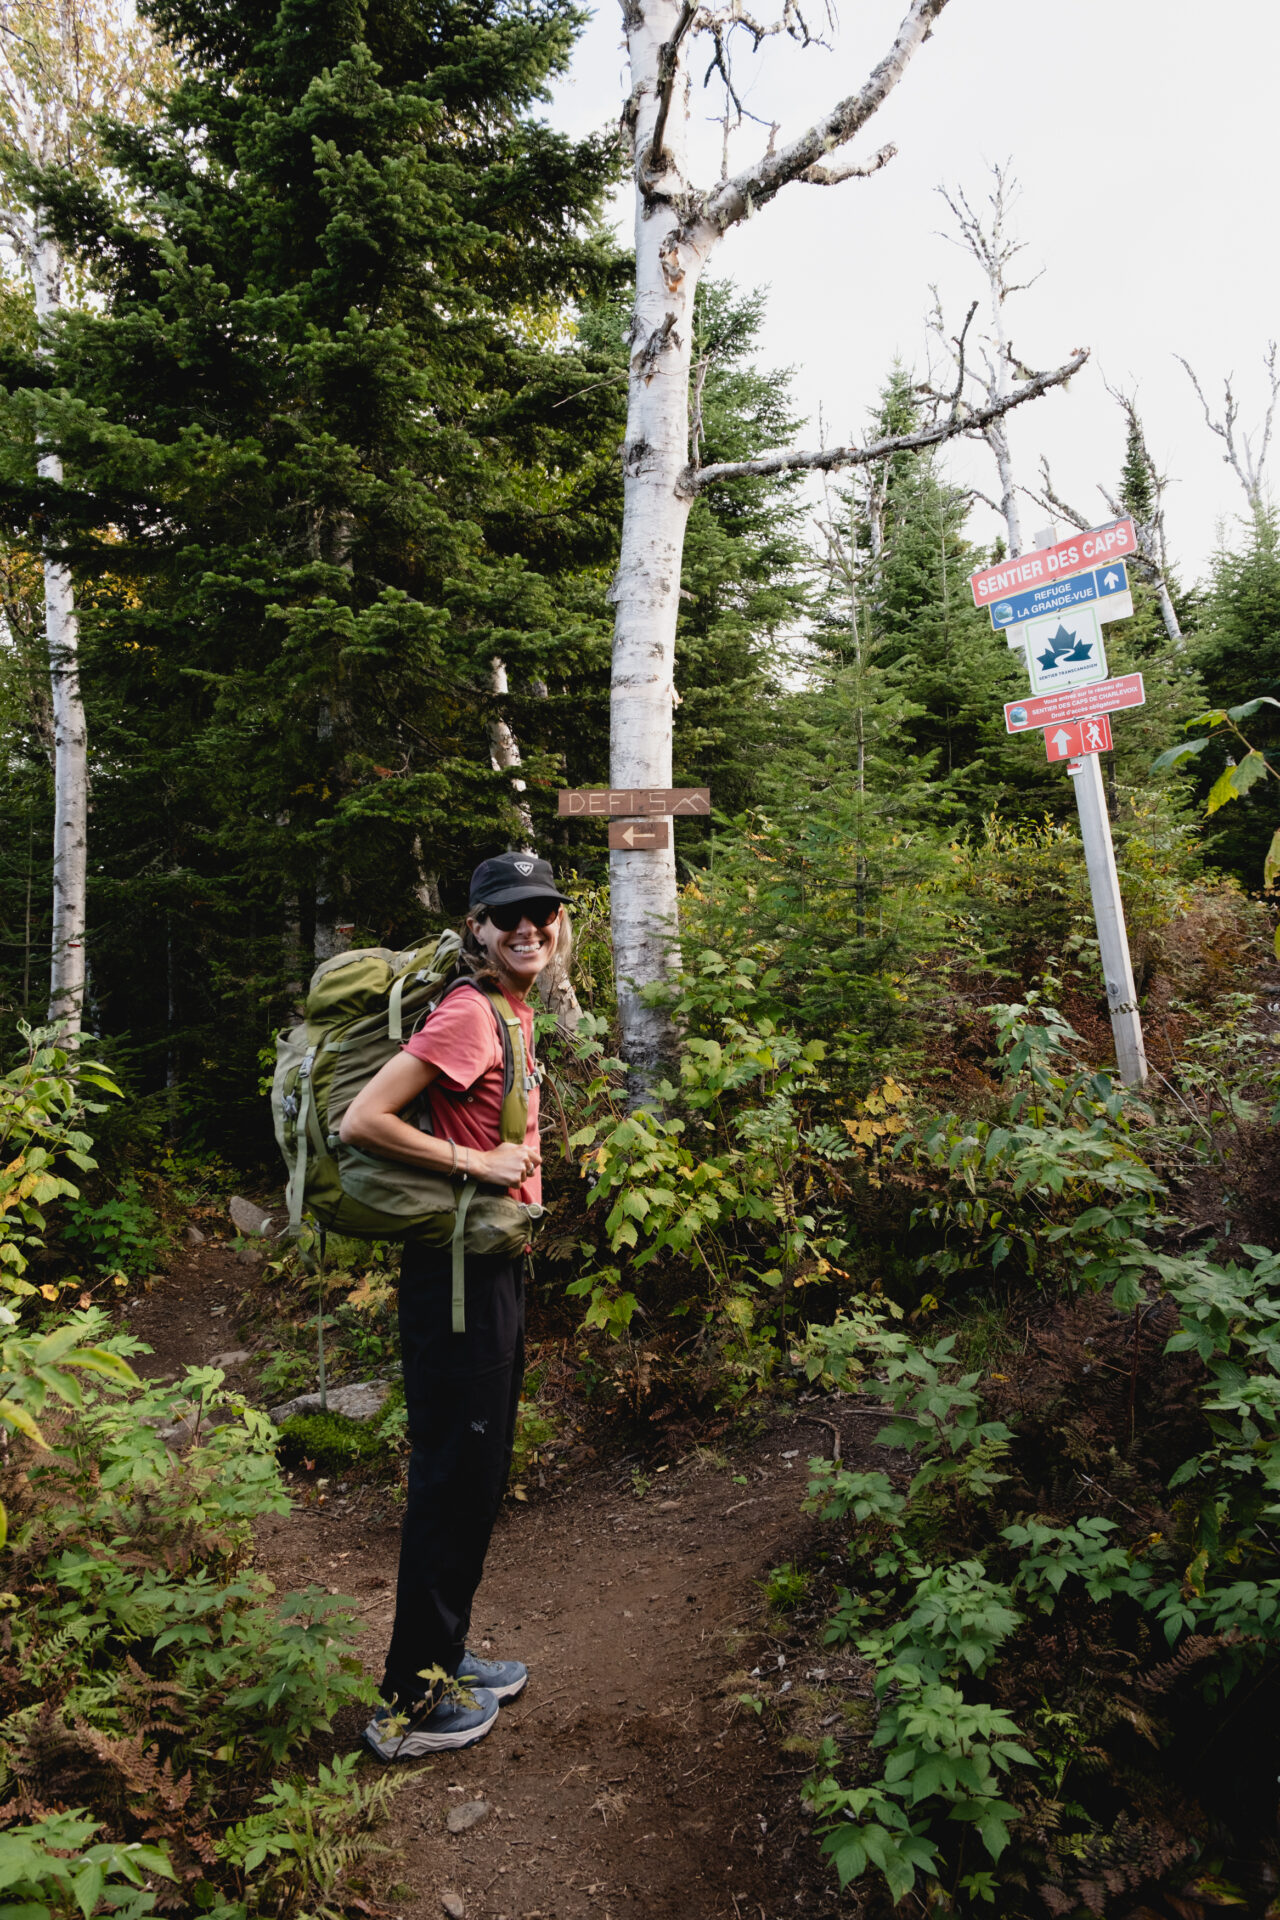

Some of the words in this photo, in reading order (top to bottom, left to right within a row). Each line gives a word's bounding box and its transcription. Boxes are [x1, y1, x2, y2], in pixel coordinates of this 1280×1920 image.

[977, 559, 1043, 597] SENTIER
[1046, 546, 1080, 573] DES
[1082, 528, 1128, 558] CAPS
[1017, 609, 1030, 618] LA
[1031, 587, 1094, 614] GRANDE-VUE
[1034, 583, 1072, 601] REFUGE
[1039, 672, 1058, 681] SENTIER
[1058, 663, 1098, 677] TRANSCANADIEN
[1115, 682, 1124, 690] du
[1032, 705, 1058, 716] SENTIER
[1071, 698, 1088, 707] CAPS
[1088, 695, 1098, 703] DE
[1098, 686, 1139, 701] CHARLEVOIX
[1051, 711, 1066, 720] Droit
[1088, 699, 1121, 712] obligatoire
